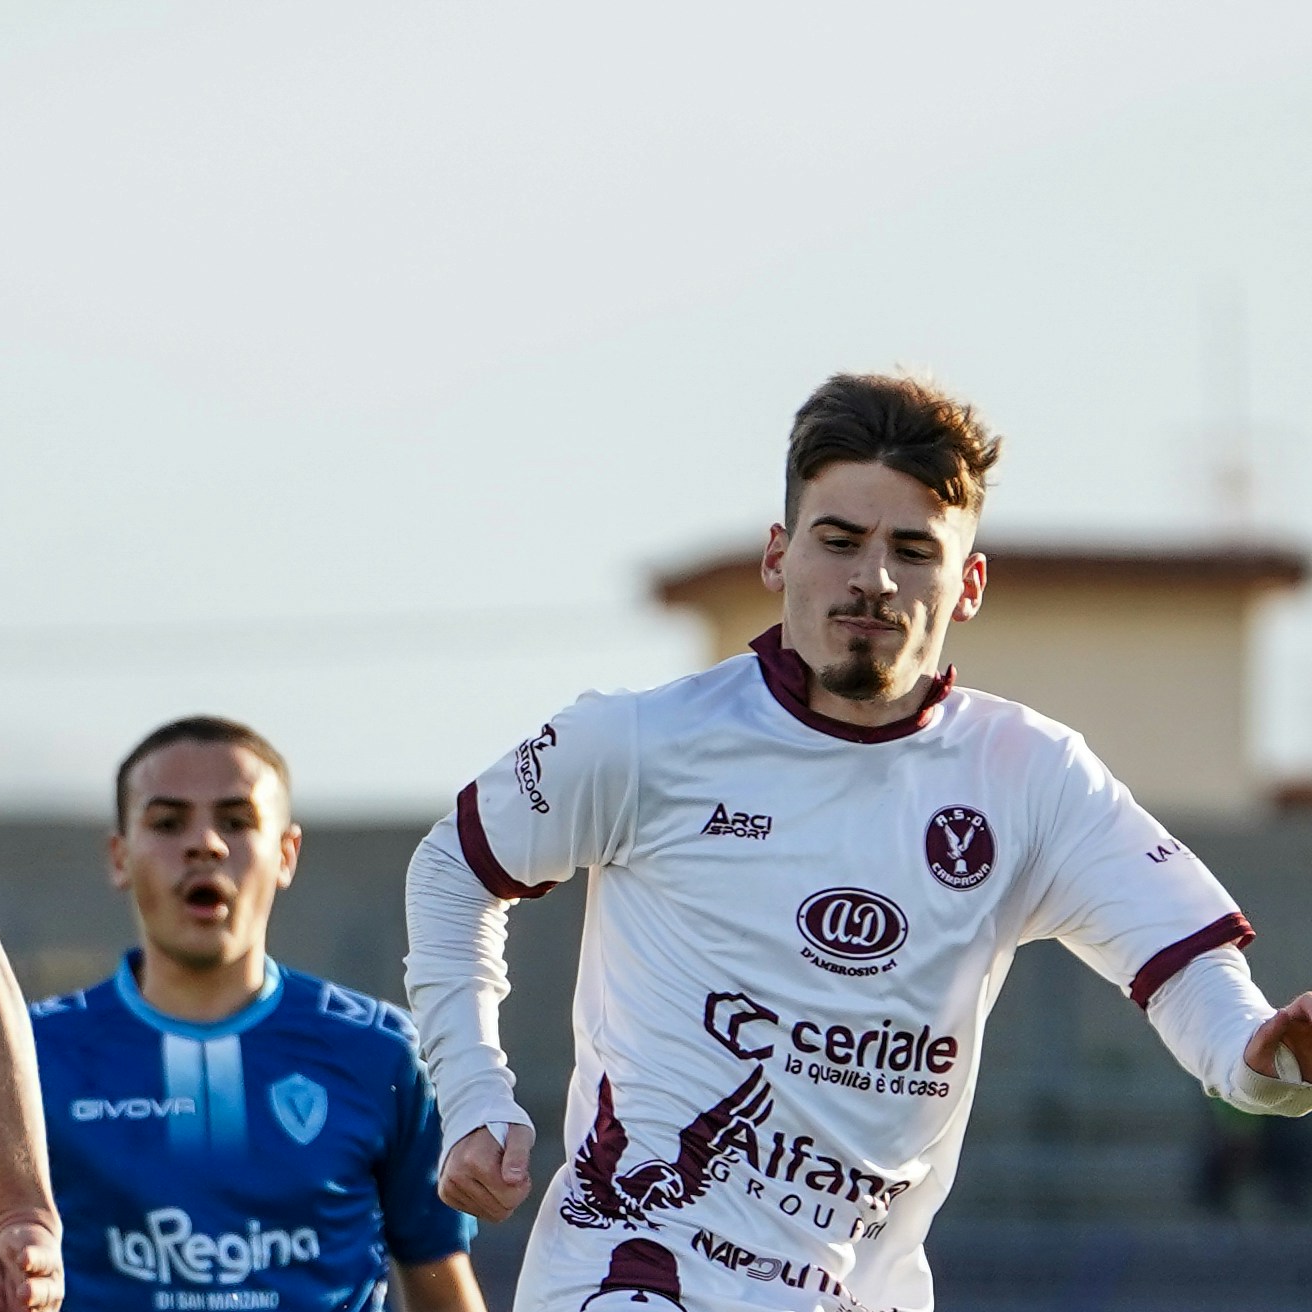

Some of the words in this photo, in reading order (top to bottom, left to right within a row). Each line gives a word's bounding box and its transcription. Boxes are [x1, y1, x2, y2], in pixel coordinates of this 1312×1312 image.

[706, 826, 769, 841] SPORT
[932, 862, 991, 886] CAMPAGNA
[800, 947, 879, 977] D'AMBROSIO
[791, 1019, 959, 1074] ceriale
[785, 1053, 803, 1075] la
[808, 1063, 871, 1091] qualità
[876, 1073, 887, 1093] è
[890, 1076, 905, 1094] di
[908, 1080, 950, 1098] casa
[71, 1097, 197, 1121] GIVOVA
